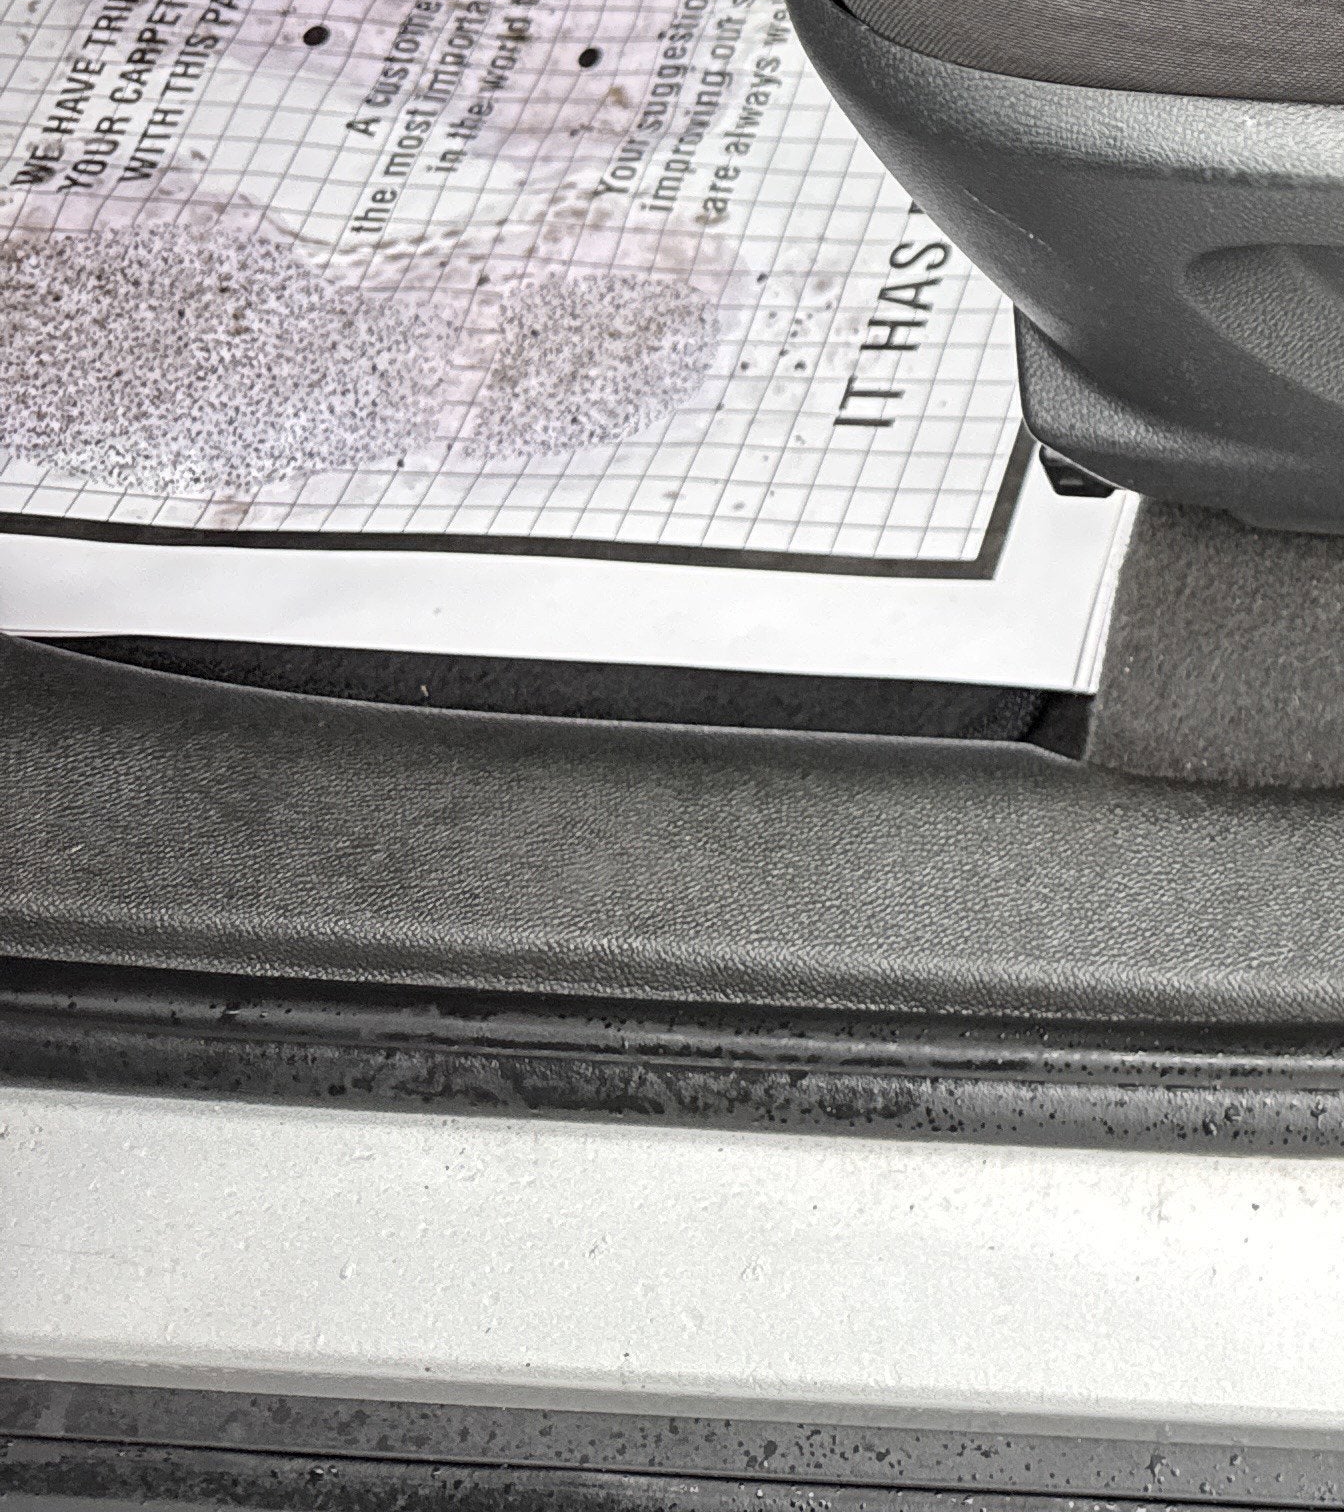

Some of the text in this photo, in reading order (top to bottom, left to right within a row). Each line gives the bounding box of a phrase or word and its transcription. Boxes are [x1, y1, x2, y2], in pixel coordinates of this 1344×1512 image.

[481, 15, 534, 90] world
[10, 139, 64, 186] WE
[42, 56, 106, 136] HAVE
[56, 115, 131, 193] YOUR
[120, 106, 184, 184] WITH
[162, 32, 219, 99] THIS
[346, 114, 382, 139] A
[446, 98, 495, 140] the
[640, 67, 733, 214] improving
[710, 15, 746, 61] our
[702, 165, 741, 217] are
[724, 55, 783, 156] always
[351, 187, 398, 236] the
[384, 107, 432, 178] most
[425, 148, 468, 174] in
[592, 134, 651, 198] Your
[833, 241, 951, 428] IT HAS
